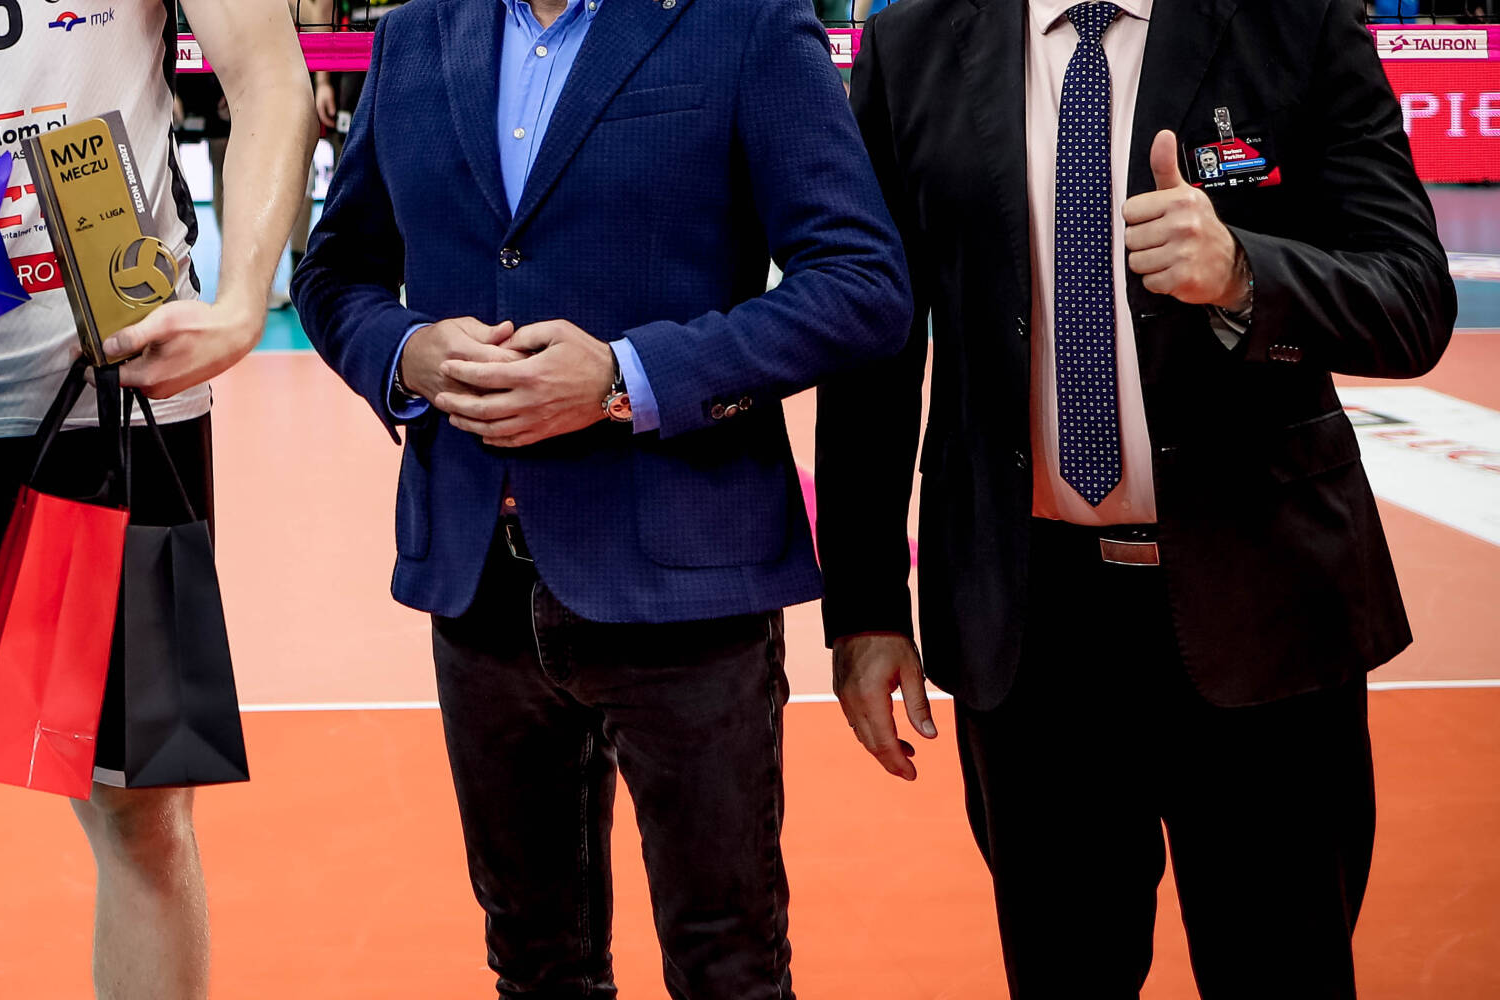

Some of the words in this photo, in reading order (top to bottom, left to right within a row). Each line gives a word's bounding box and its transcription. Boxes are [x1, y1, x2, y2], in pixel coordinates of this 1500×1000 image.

[90, 7, 115, 27] mpk
[1412, 38, 1477, 51] TAURON
[50, 135, 103, 168] MVP
[60, 158, 108, 183] MECZU
[130, 185, 145, 214] SEZON
[106, 207, 125, 219] LIGA
[2, 228, 32, 239] ntainer
